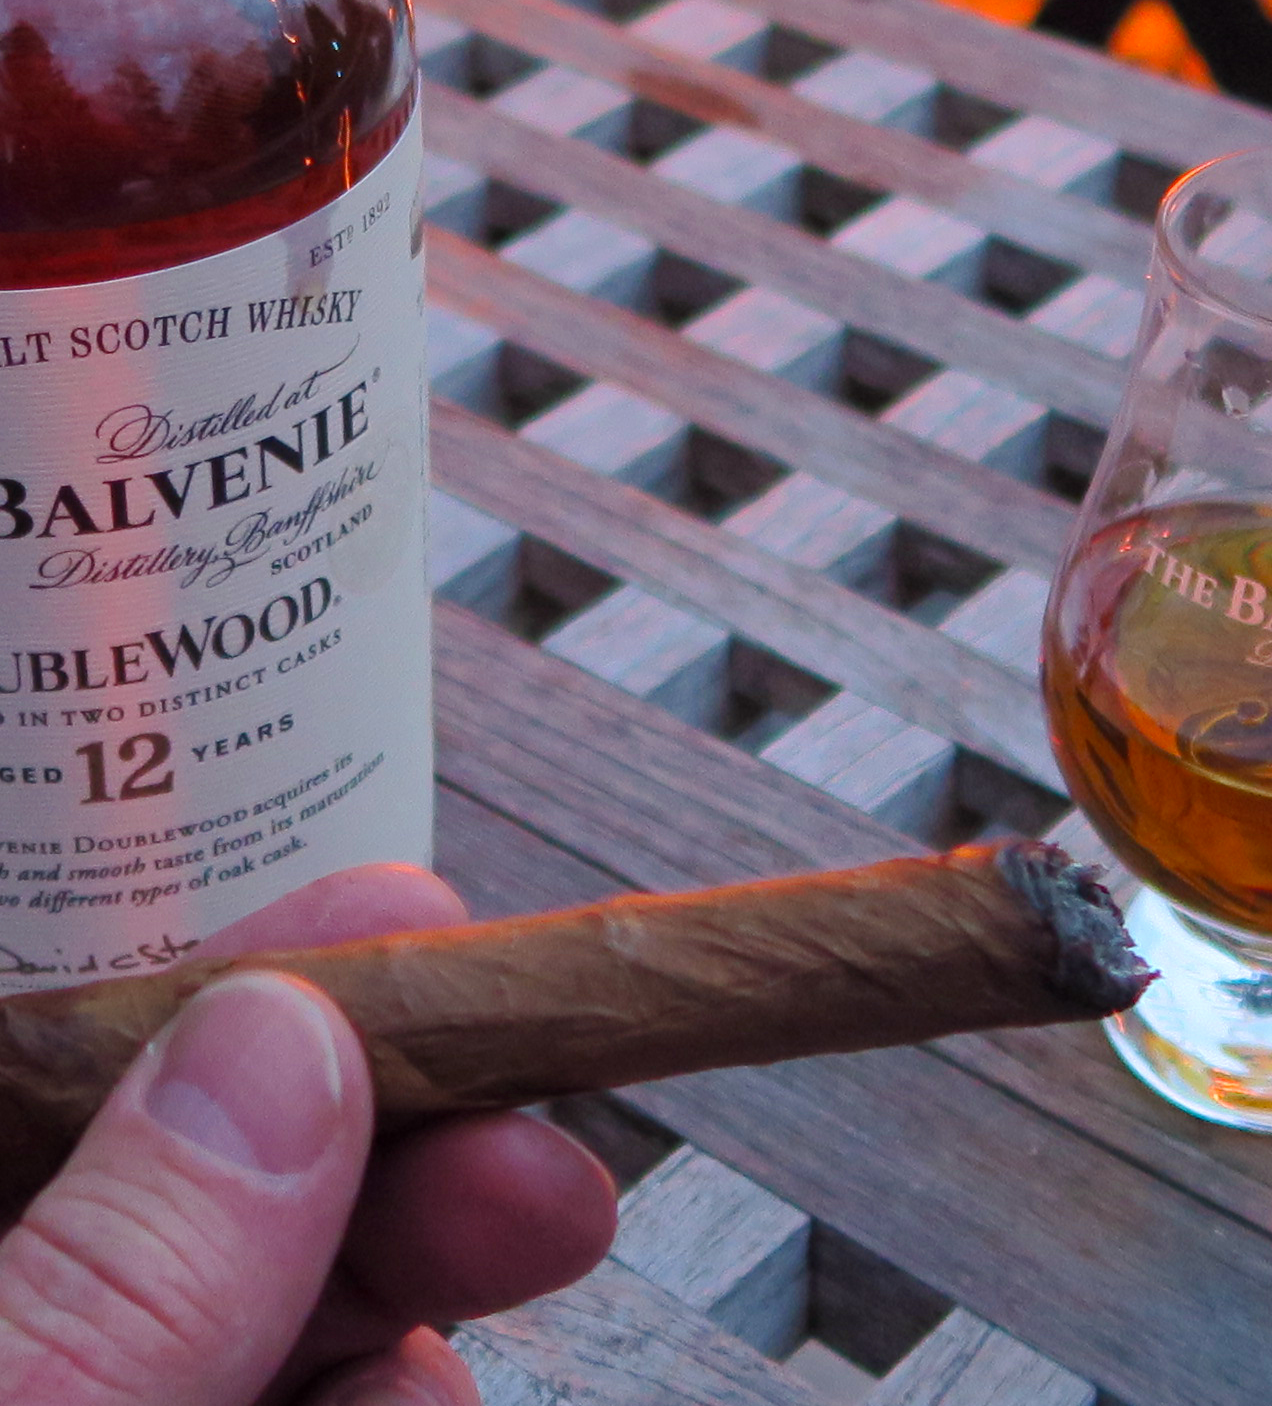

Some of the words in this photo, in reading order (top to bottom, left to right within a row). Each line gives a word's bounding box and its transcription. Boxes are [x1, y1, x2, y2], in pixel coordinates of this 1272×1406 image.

[361, 192, 391, 233] 1892
[71, 307, 231, 360] SCOTCH
[248, 289, 363, 333] WHISKY
[96, 382, 285, 464] Distilled
[208, 458, 380, 588] Banffshire
[271, 503, 373, 576] SCOTLAND
[1140, 537, 1218, 610] THE
[19, 711, 49, 728] IN
[61, 706, 125, 727] TWO
[139, 669, 268, 719] DISTINCT
[277, 628, 343, 674] CASKS
[75, 731, 175, 806] 12
[191, 713, 295, 764] YEARS
[253, 766, 331, 817] acquires
[333, 752, 354, 774] its
[17, 864, 62, 882] and
[68, 857, 146, 882] smooth
[154, 848, 205, 871] taste
[212, 828, 265, 858] from
[271, 813, 294, 836] its
[300, 751, 385, 822] maturation
[28, 888, 122, 914] different
[131, 881, 182, 907] types
[188, 866, 213, 892] of
[218, 855, 256, 883] oak
[262, 835, 308, 866] cask.
